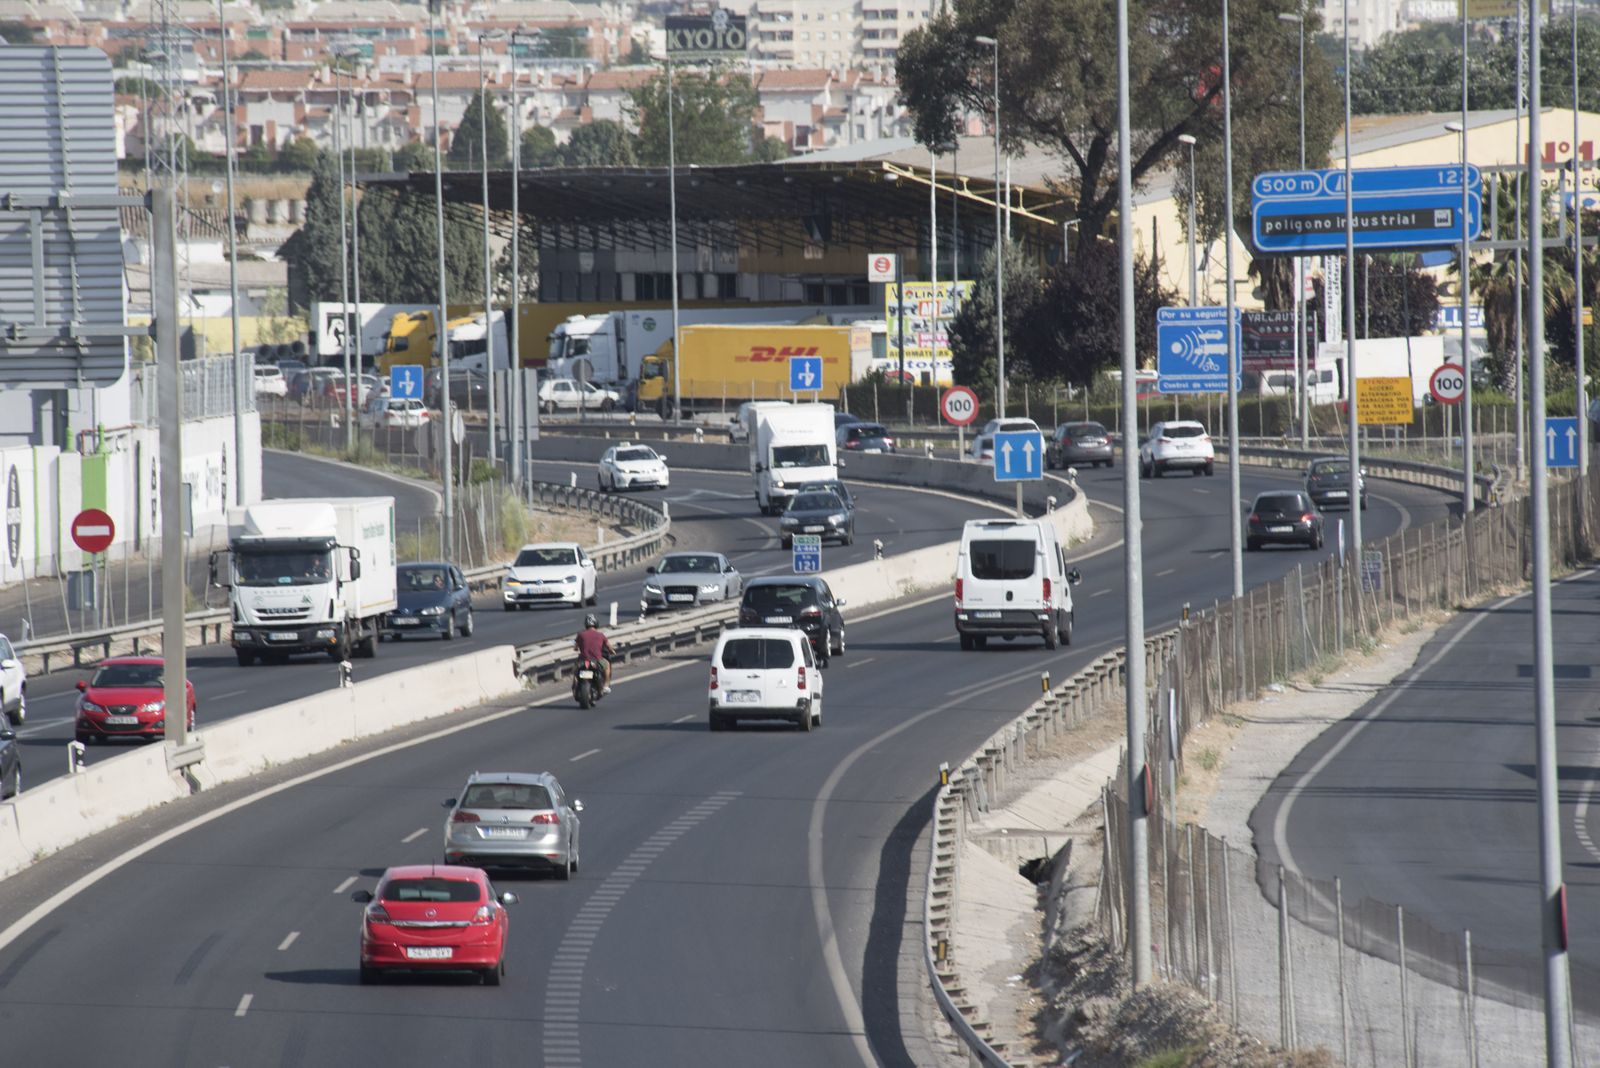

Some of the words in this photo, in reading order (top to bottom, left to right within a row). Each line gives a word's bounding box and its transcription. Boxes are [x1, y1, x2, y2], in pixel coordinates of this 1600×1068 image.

[667, 28, 745, 50] KYOTO
[1261, 179, 1296, 192] 500
[1301, 180, 1315, 191] m
[1161, 311, 1176, 319] Por
[1196, 310, 1238, 319] segurid
[1436, 378, 1463, 391] 100
[948, 399, 972, 412] 100
[798, 560, 816, 571] 121
